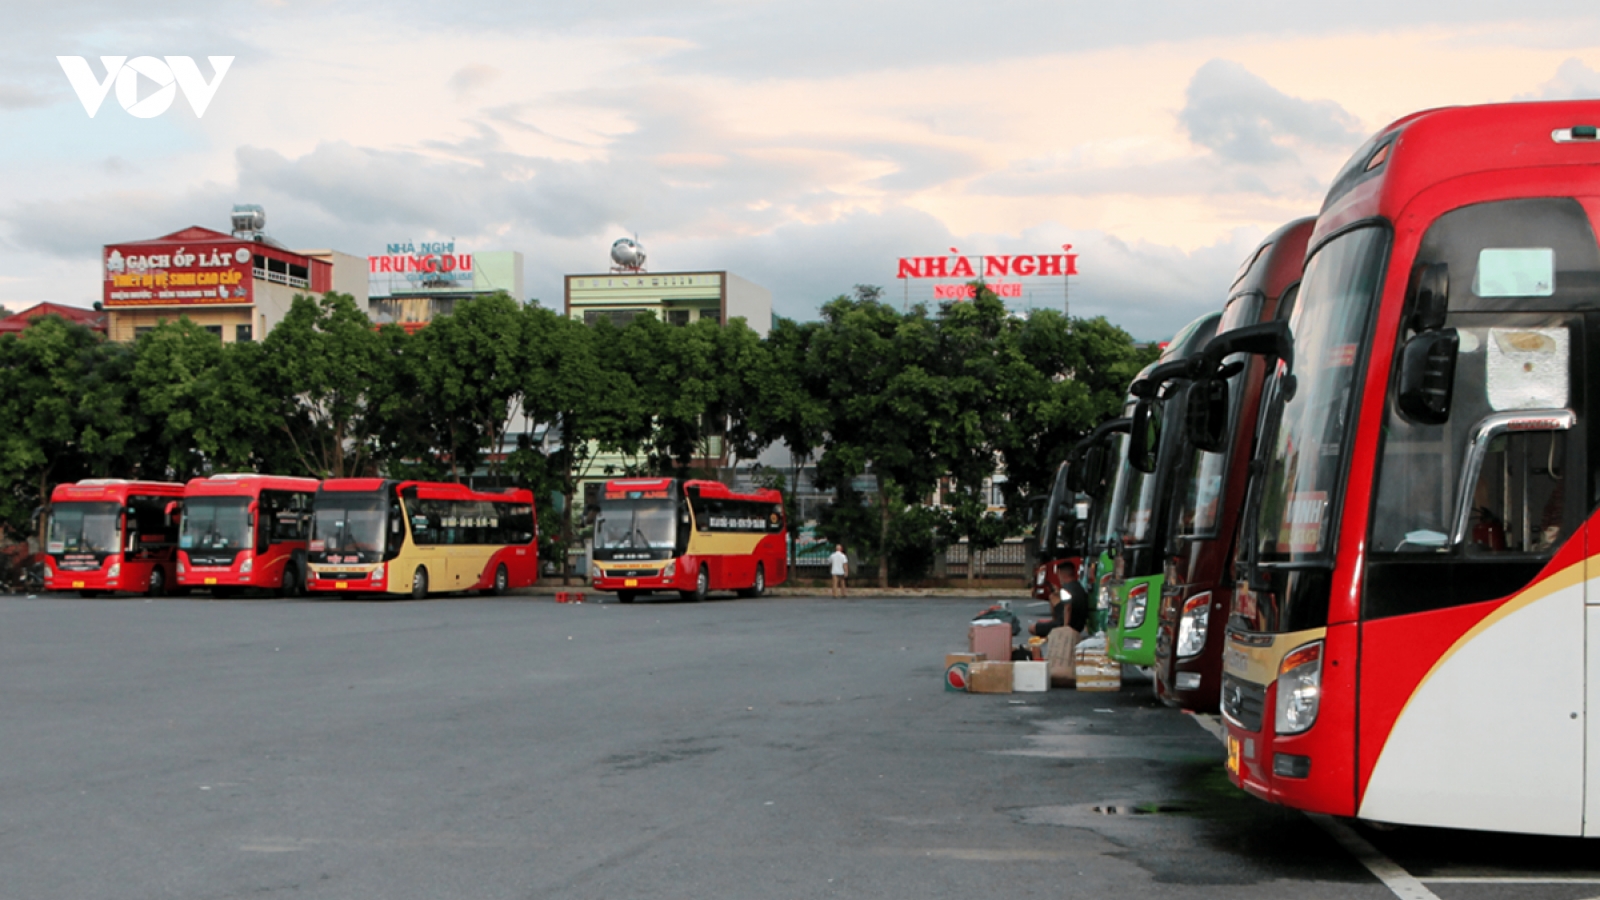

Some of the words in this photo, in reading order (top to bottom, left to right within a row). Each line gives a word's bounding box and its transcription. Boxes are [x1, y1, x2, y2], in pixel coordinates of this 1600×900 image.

[126, 255, 171, 272] GẠCH
[173, 247, 196, 268] ỐP
[199, 248, 232, 267] LÁT
[367, 254, 436, 273] TRUNG
[441, 254, 472, 272] DU
[897, 247, 975, 278] NHÀ
[984, 244, 1079, 276] NGHỈ
[197, 272, 218, 285] CAO
[220, 268, 243, 284] CẤP
[933, 283, 976, 301] NGỌC
